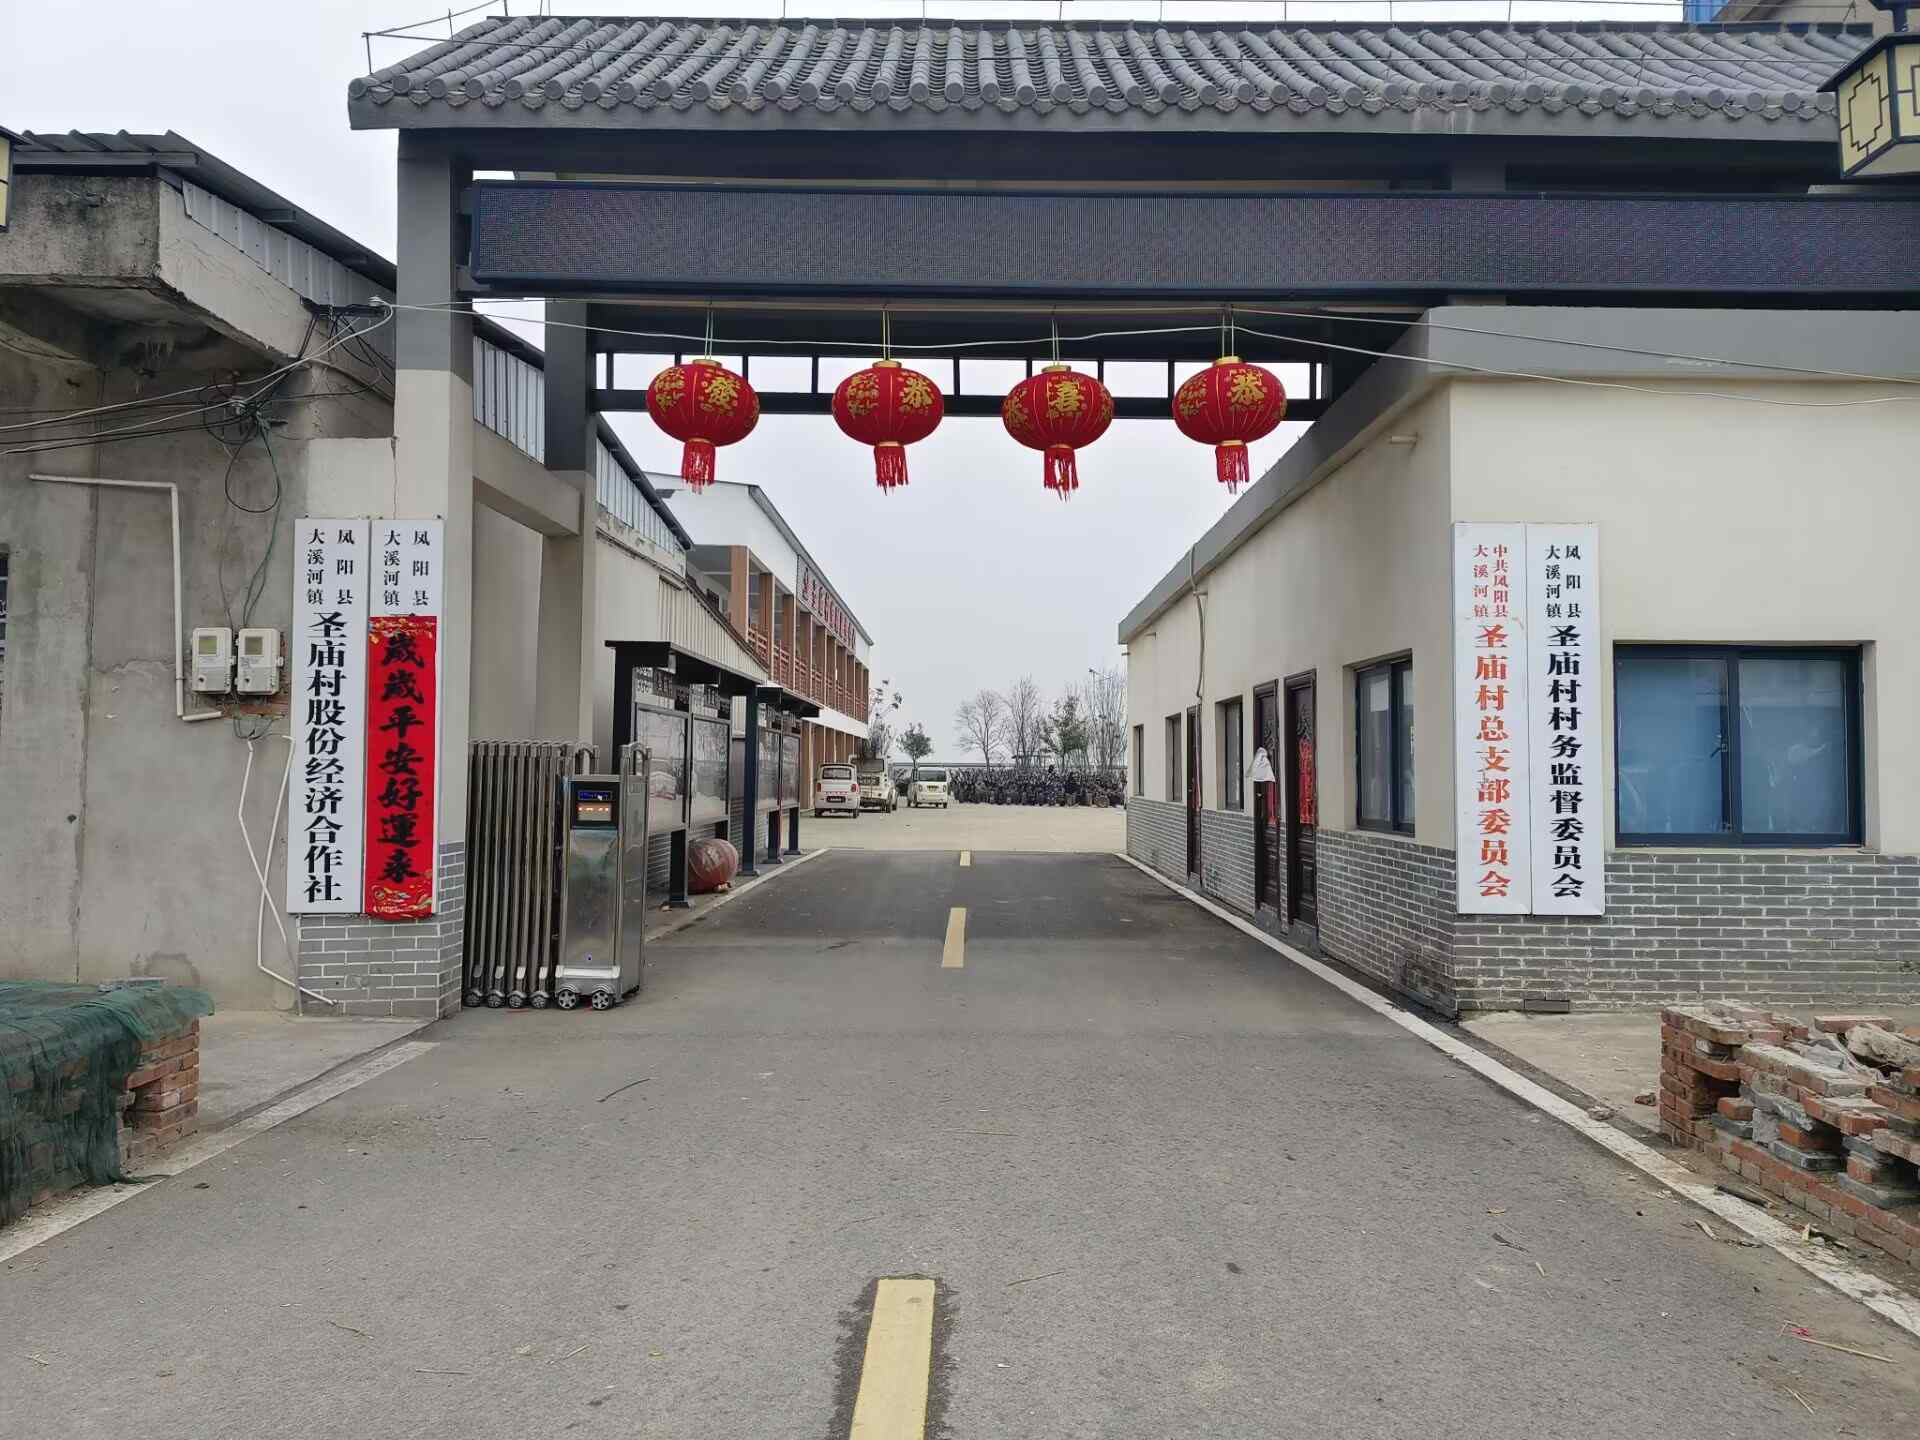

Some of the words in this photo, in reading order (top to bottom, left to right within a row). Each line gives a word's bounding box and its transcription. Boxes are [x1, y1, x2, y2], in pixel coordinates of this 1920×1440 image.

[307, 528, 325, 605] 大溪河镇
[336, 529, 355, 605] 凤阳县
[383, 530, 401, 606] 大溪河镇
[412, 530, 430, 606] 凤阳县
[1473, 544, 1489, 618] 大溪河镇
[1493, 544, 1509, 618] 中共凤阳县
[1544, 544, 1561, 618] 大溪河镇
[1565, 545, 1581, 618] 凤阳县
[303, 611, 348, 903] 圣庙村股份经济合作社
[1474, 624, 1512, 898] 圣庙村总支部委员会
[1547, 624, 1585, 898] 圣庙村村务监督委员会
